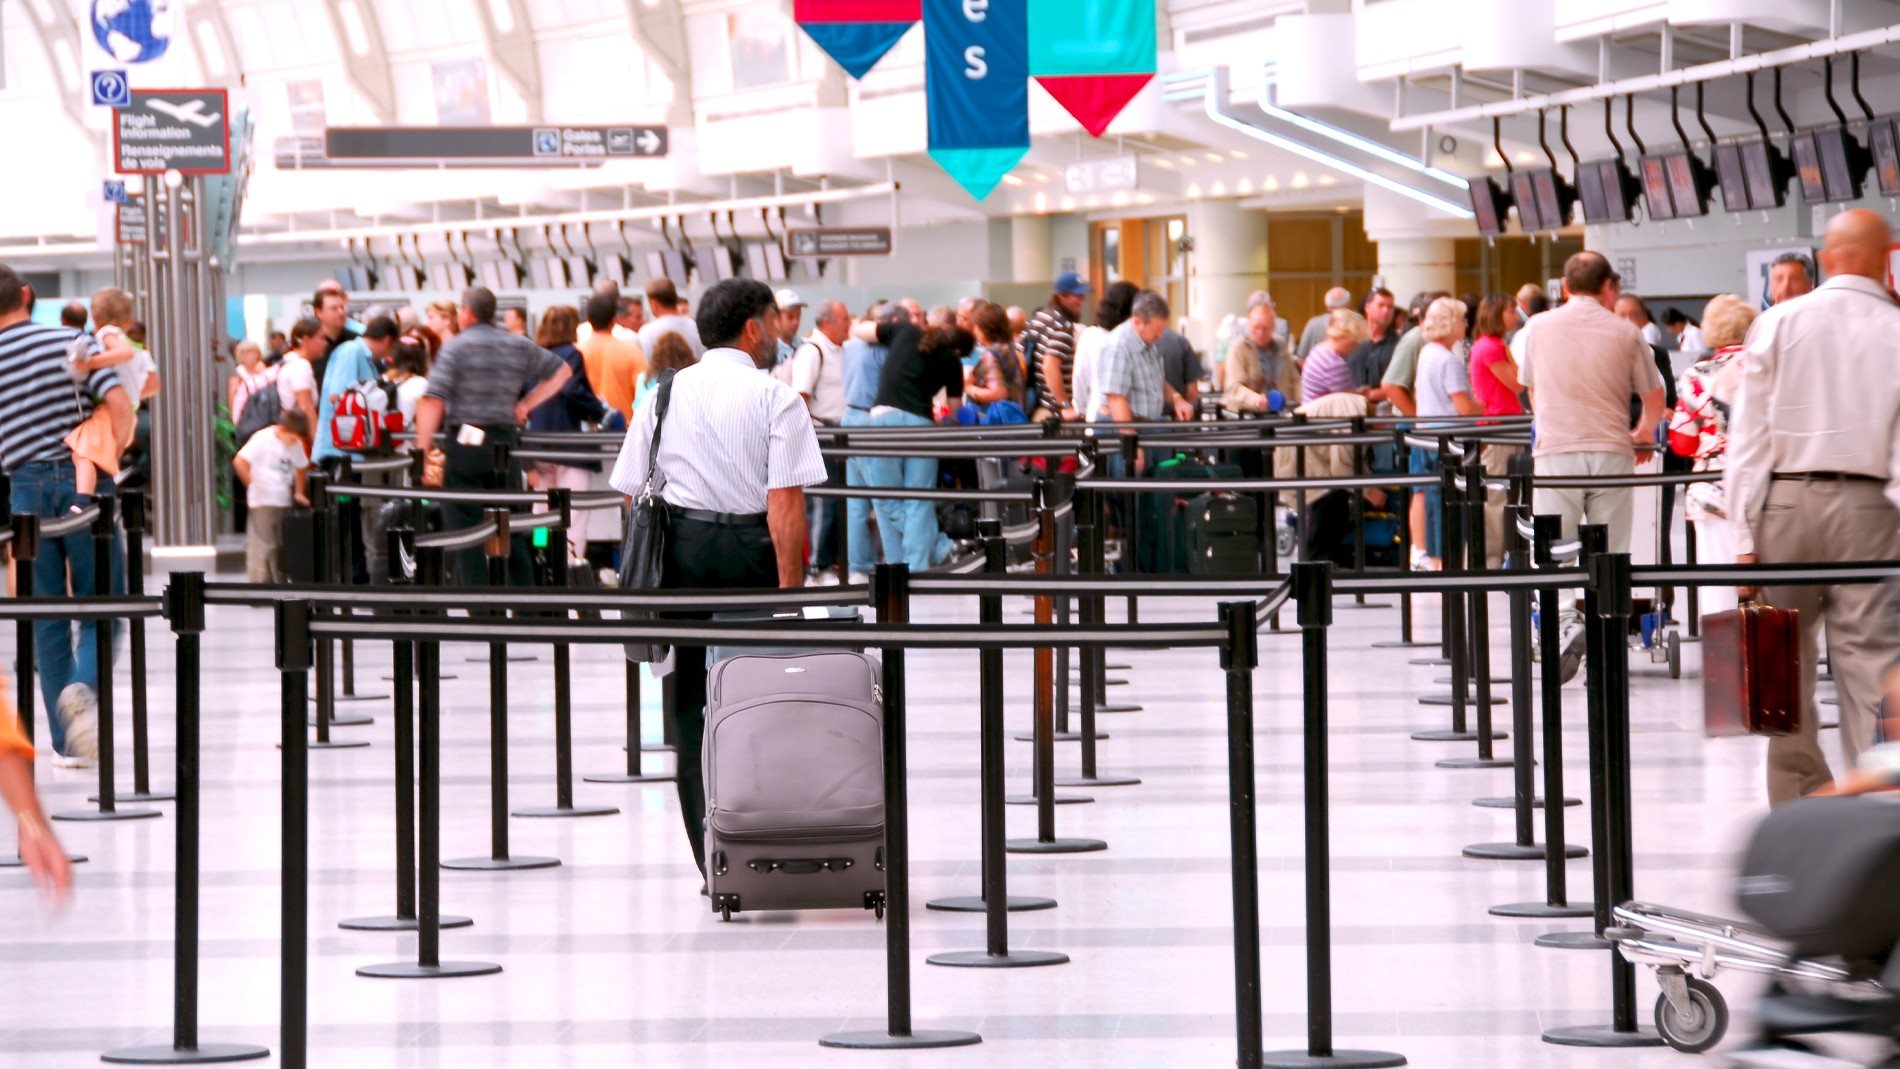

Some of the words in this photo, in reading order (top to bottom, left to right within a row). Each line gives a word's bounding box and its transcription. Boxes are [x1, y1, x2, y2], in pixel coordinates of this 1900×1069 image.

[121, 113, 156, 128] Flight
[121, 127, 191, 139] Information
[562, 128, 601, 141] Gates
[121, 144, 223, 159] Renseignements
[562, 142, 606, 155] Portes
[121, 158, 138, 169] de
[140, 157, 166, 169] vols
